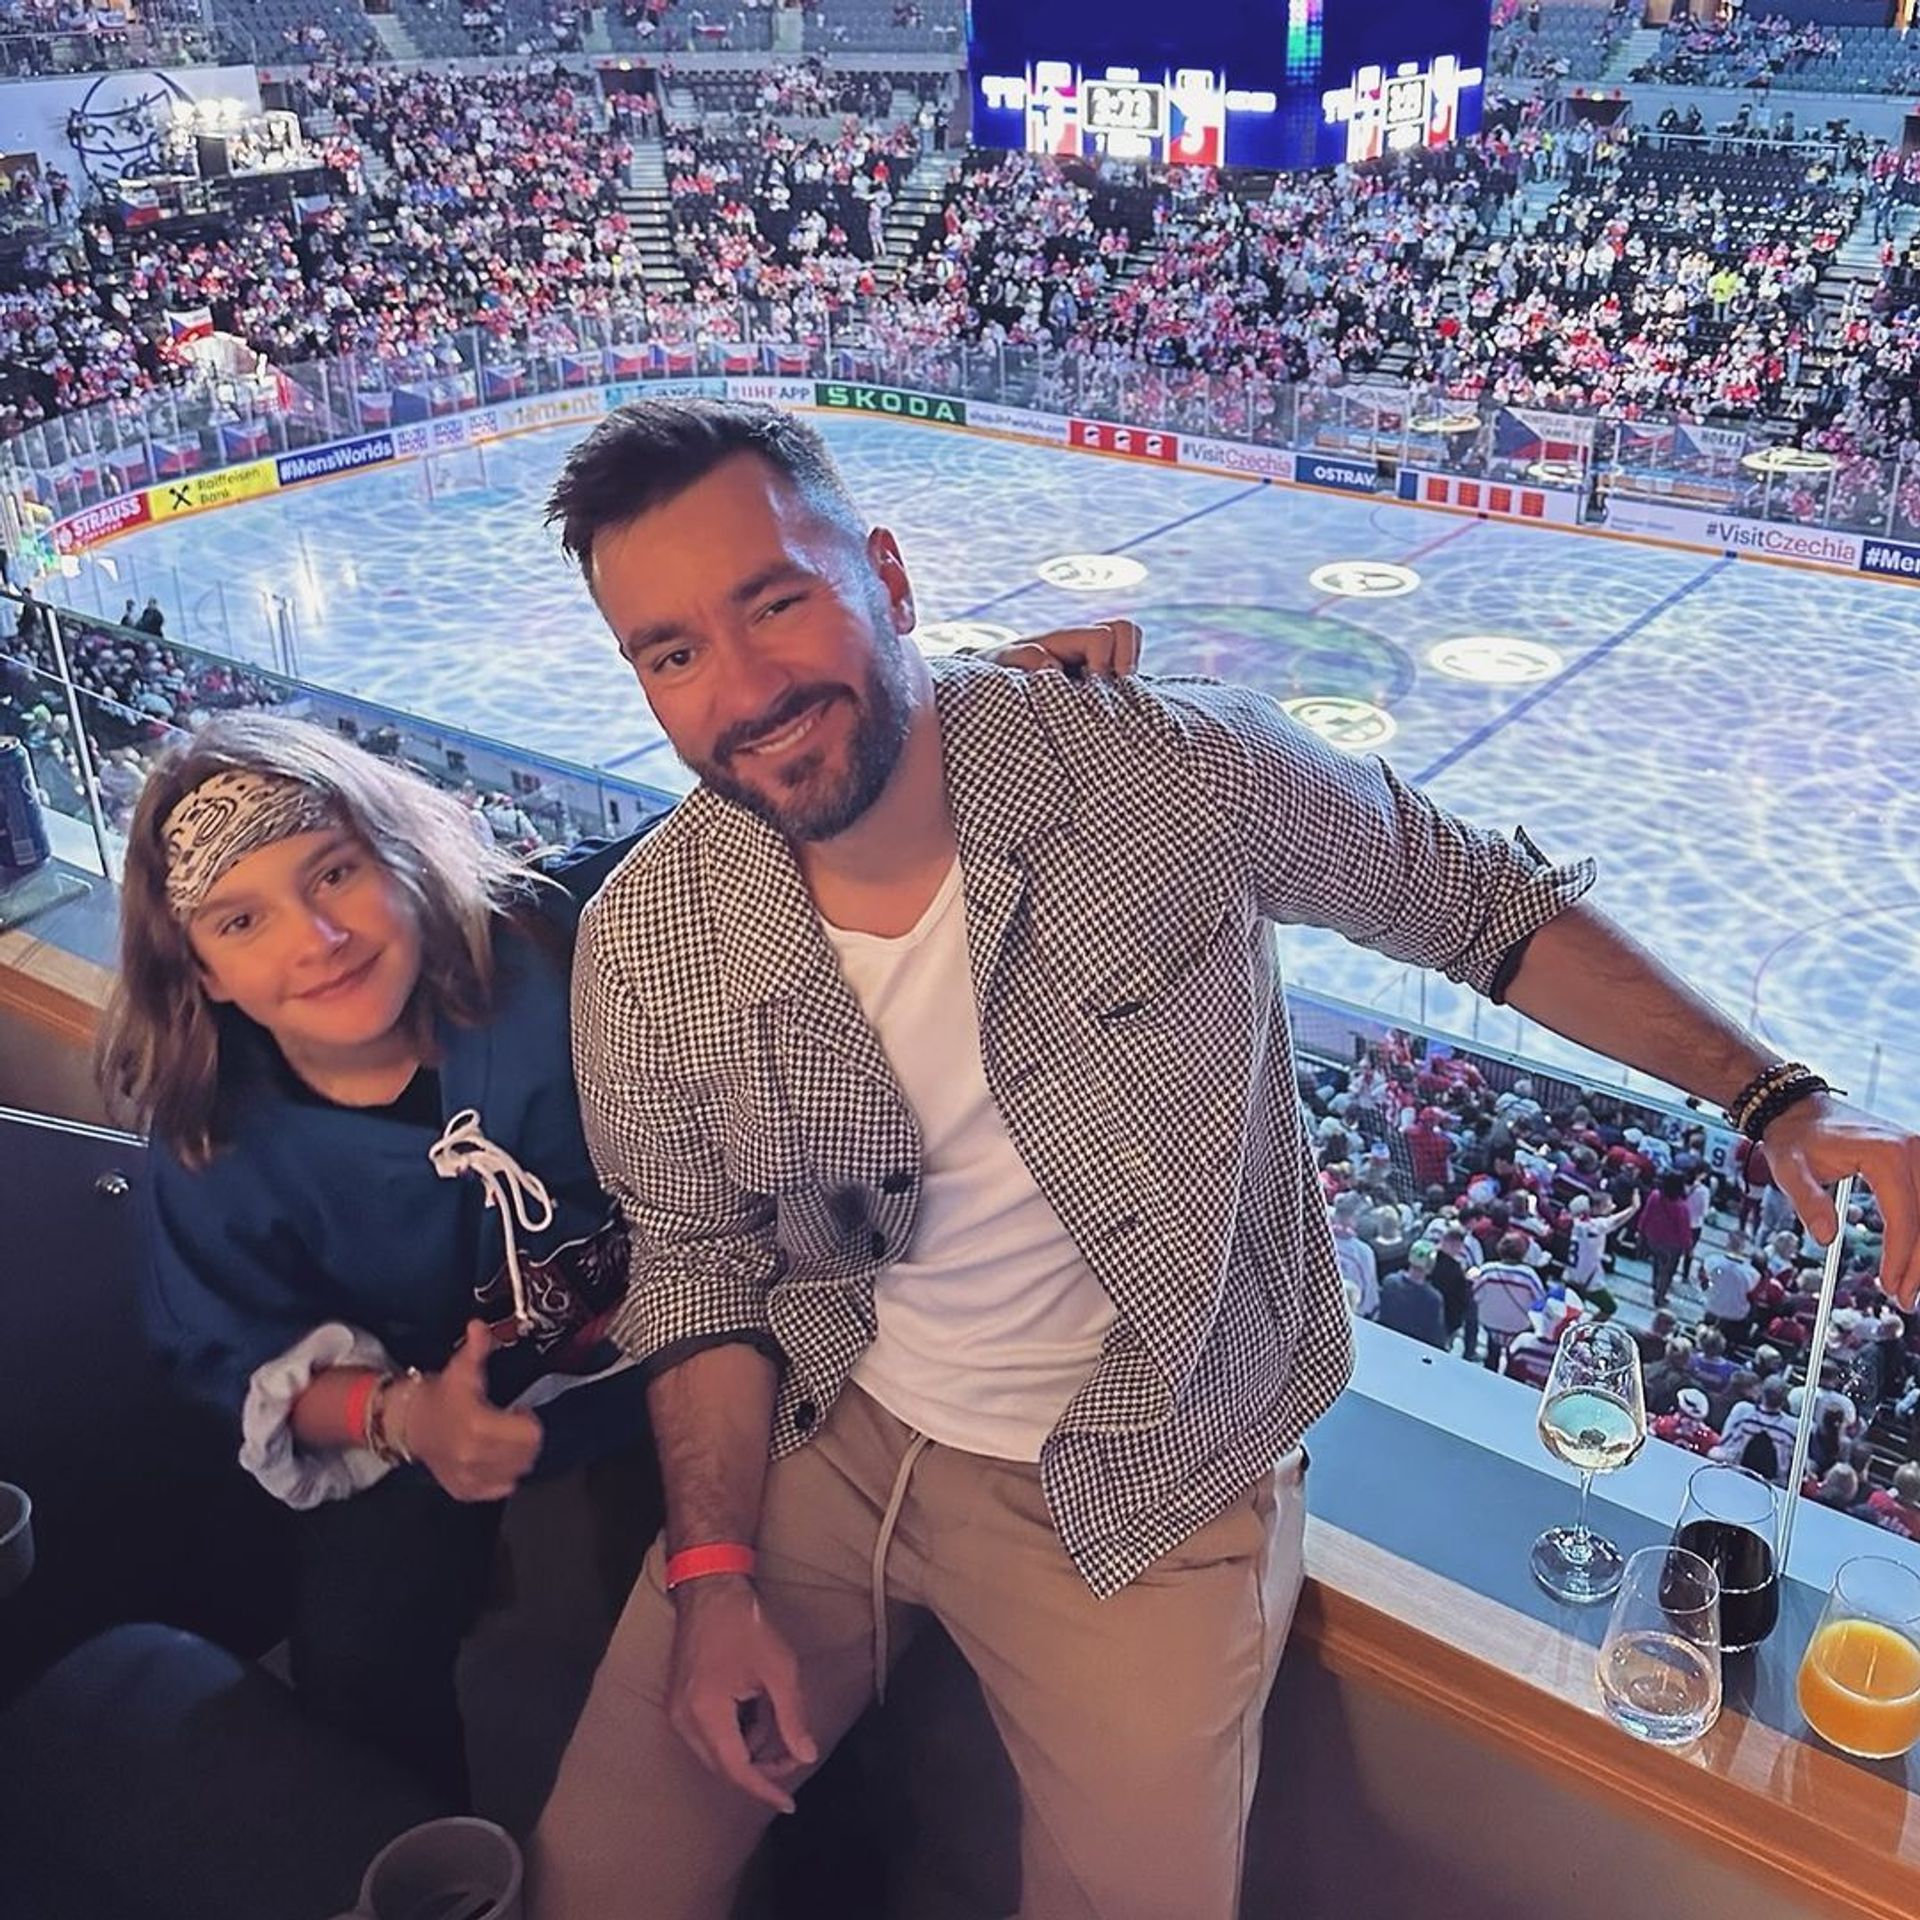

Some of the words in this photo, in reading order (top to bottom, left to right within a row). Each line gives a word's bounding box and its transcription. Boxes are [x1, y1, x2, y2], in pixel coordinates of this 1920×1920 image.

[280, 439, 393, 482] #MensWorlds
[198, 467, 261, 490] Raiffeisen
[1313, 465, 1378, 489] OSTRAV
[72, 497, 141, 538] STRAUSS
[1706, 520, 1857, 563] #VisitCzechia
[1711, 1147, 1727, 1168] 9
